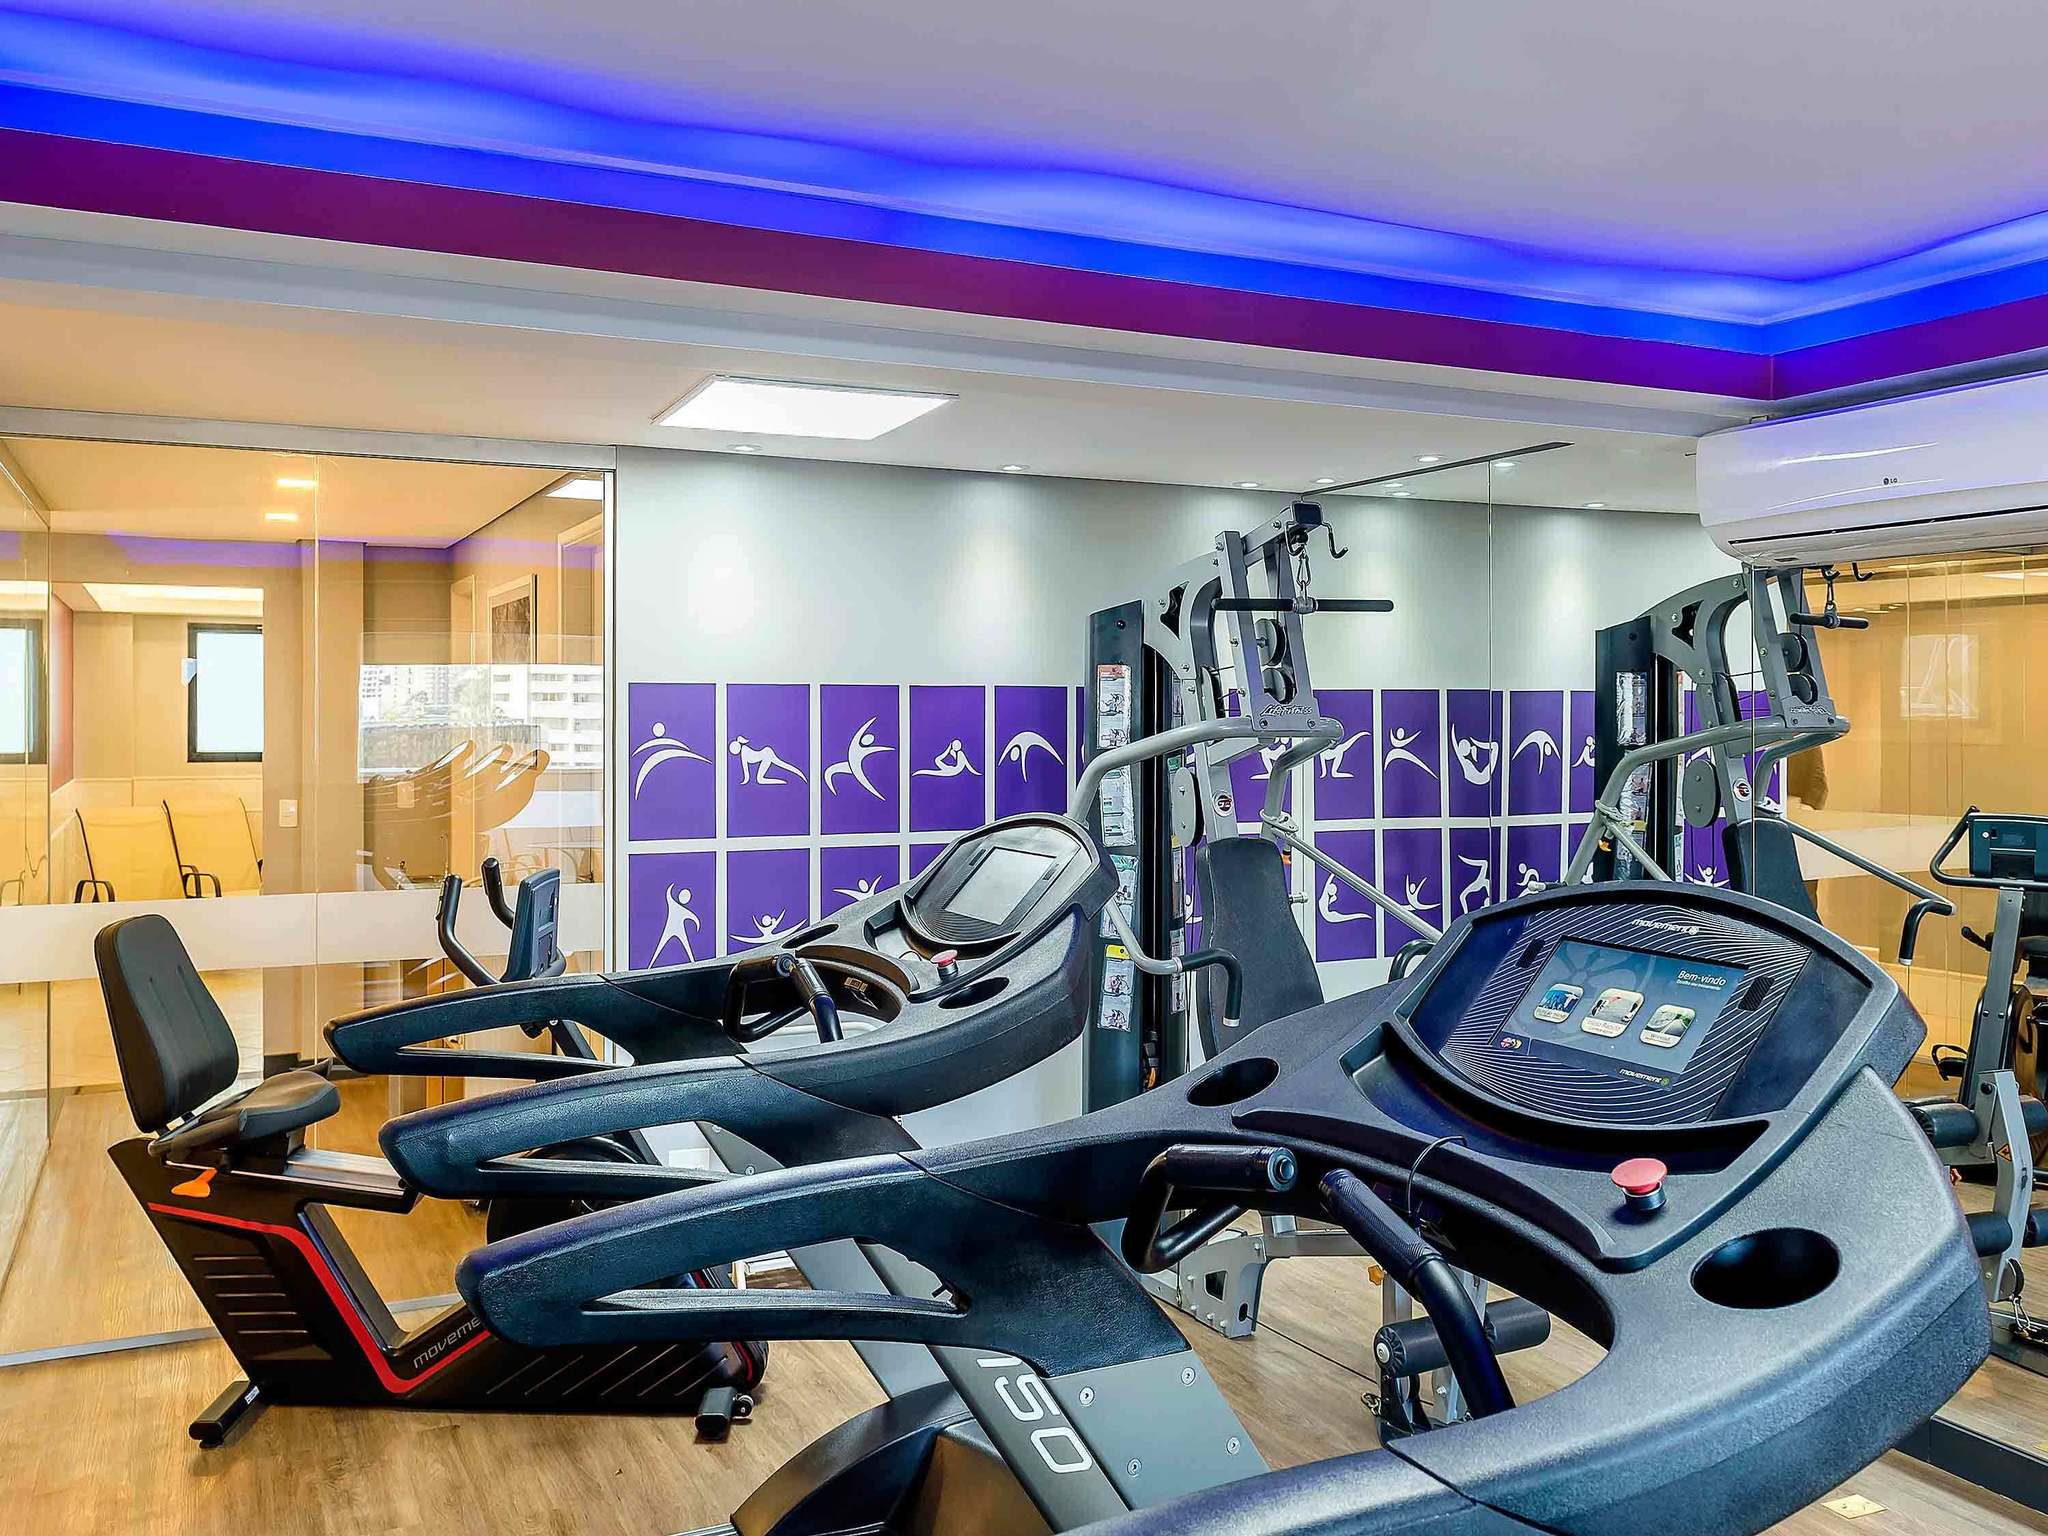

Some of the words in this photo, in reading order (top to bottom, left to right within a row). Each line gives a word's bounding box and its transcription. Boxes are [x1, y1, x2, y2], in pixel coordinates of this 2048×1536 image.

[1631, 918, 1691, 933] movement
[1677, 969, 1727, 986] Bem-vindo
[1619, 1068, 1662, 1083] movement
